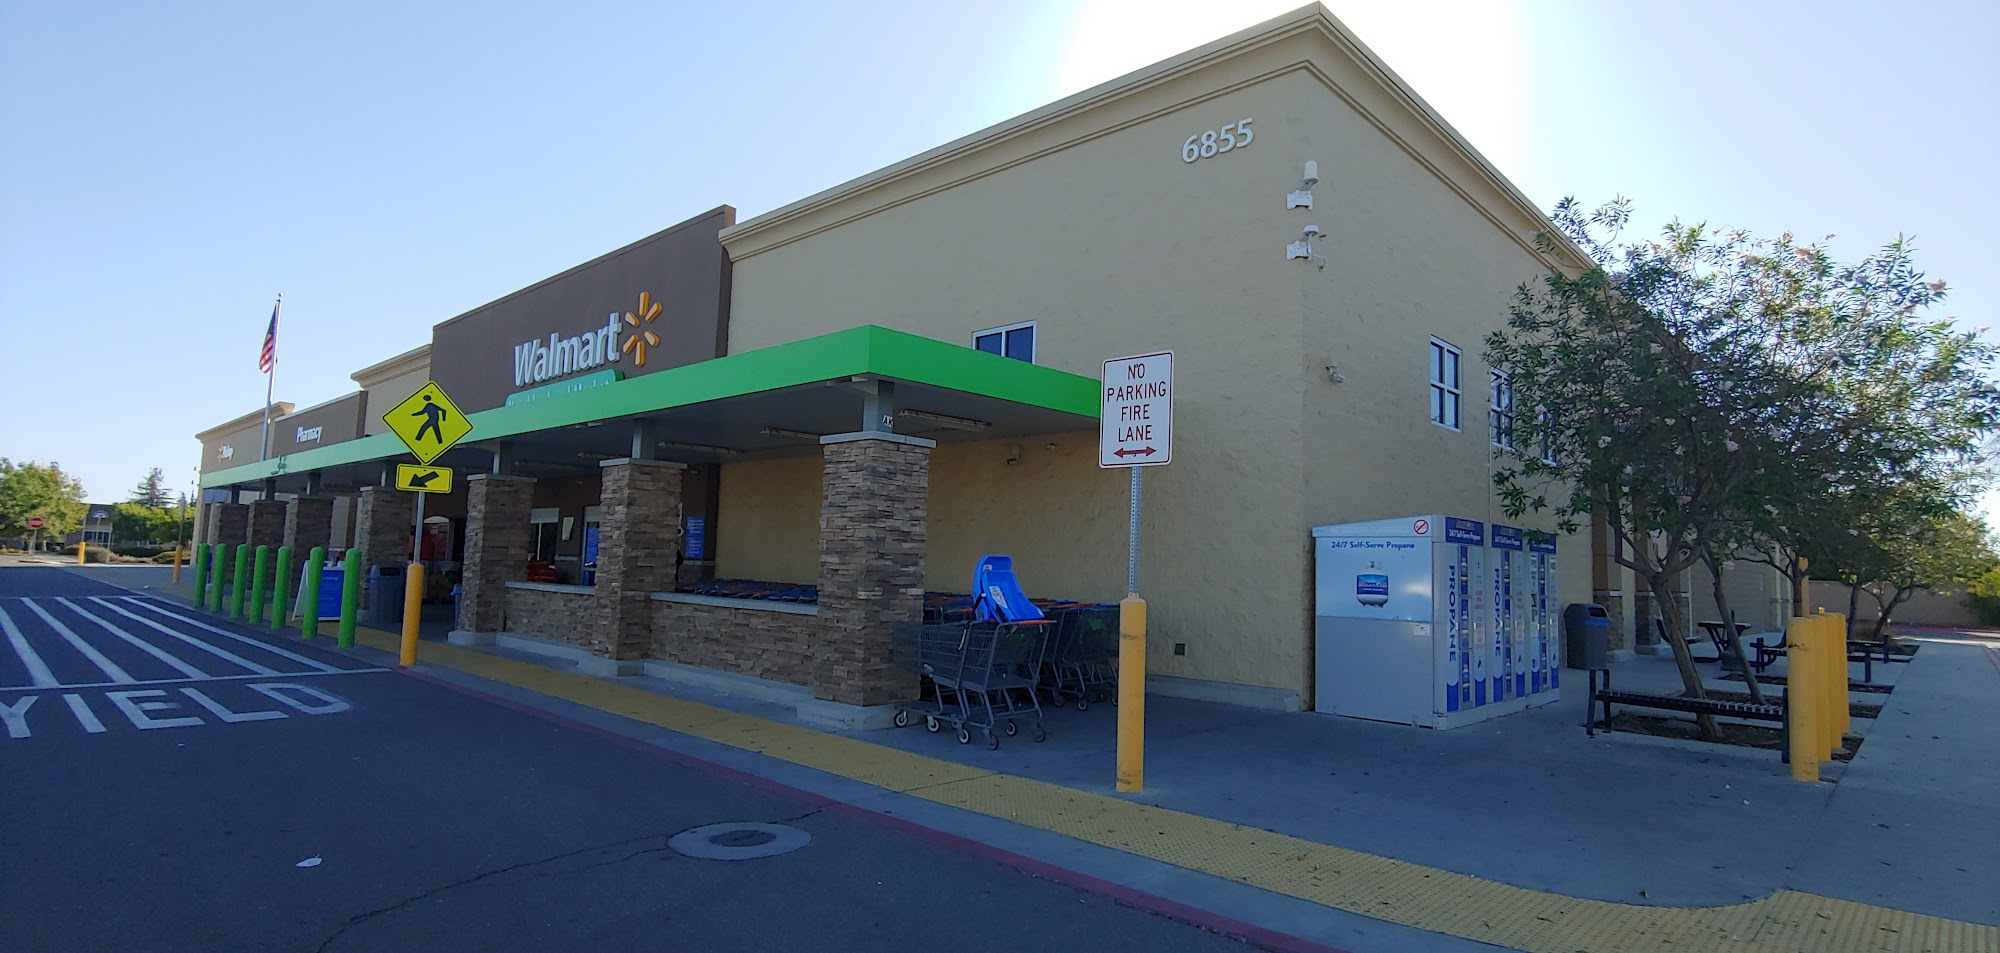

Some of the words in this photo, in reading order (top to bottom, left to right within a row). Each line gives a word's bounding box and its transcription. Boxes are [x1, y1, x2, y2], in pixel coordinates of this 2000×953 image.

[1182, 117, 1254, 163] 6855
[515, 312, 622, 387] Walmart
[1127, 363, 1146, 380] NO
[1107, 381, 1167, 402] PARKING
[1121, 404, 1150, 421] FIRE
[296, 426, 323, 443] Pharmacy
[1118, 425, 1152, 442] LANE
[1331, 541, 1348, 549] 24/7
[1349, 541, 1384, 549] Self-Serve
[1386, 541, 1415, 551] Propane
[1449, 565, 1457, 662] PROPANE
[0, 682, 351, 739] YIELD
